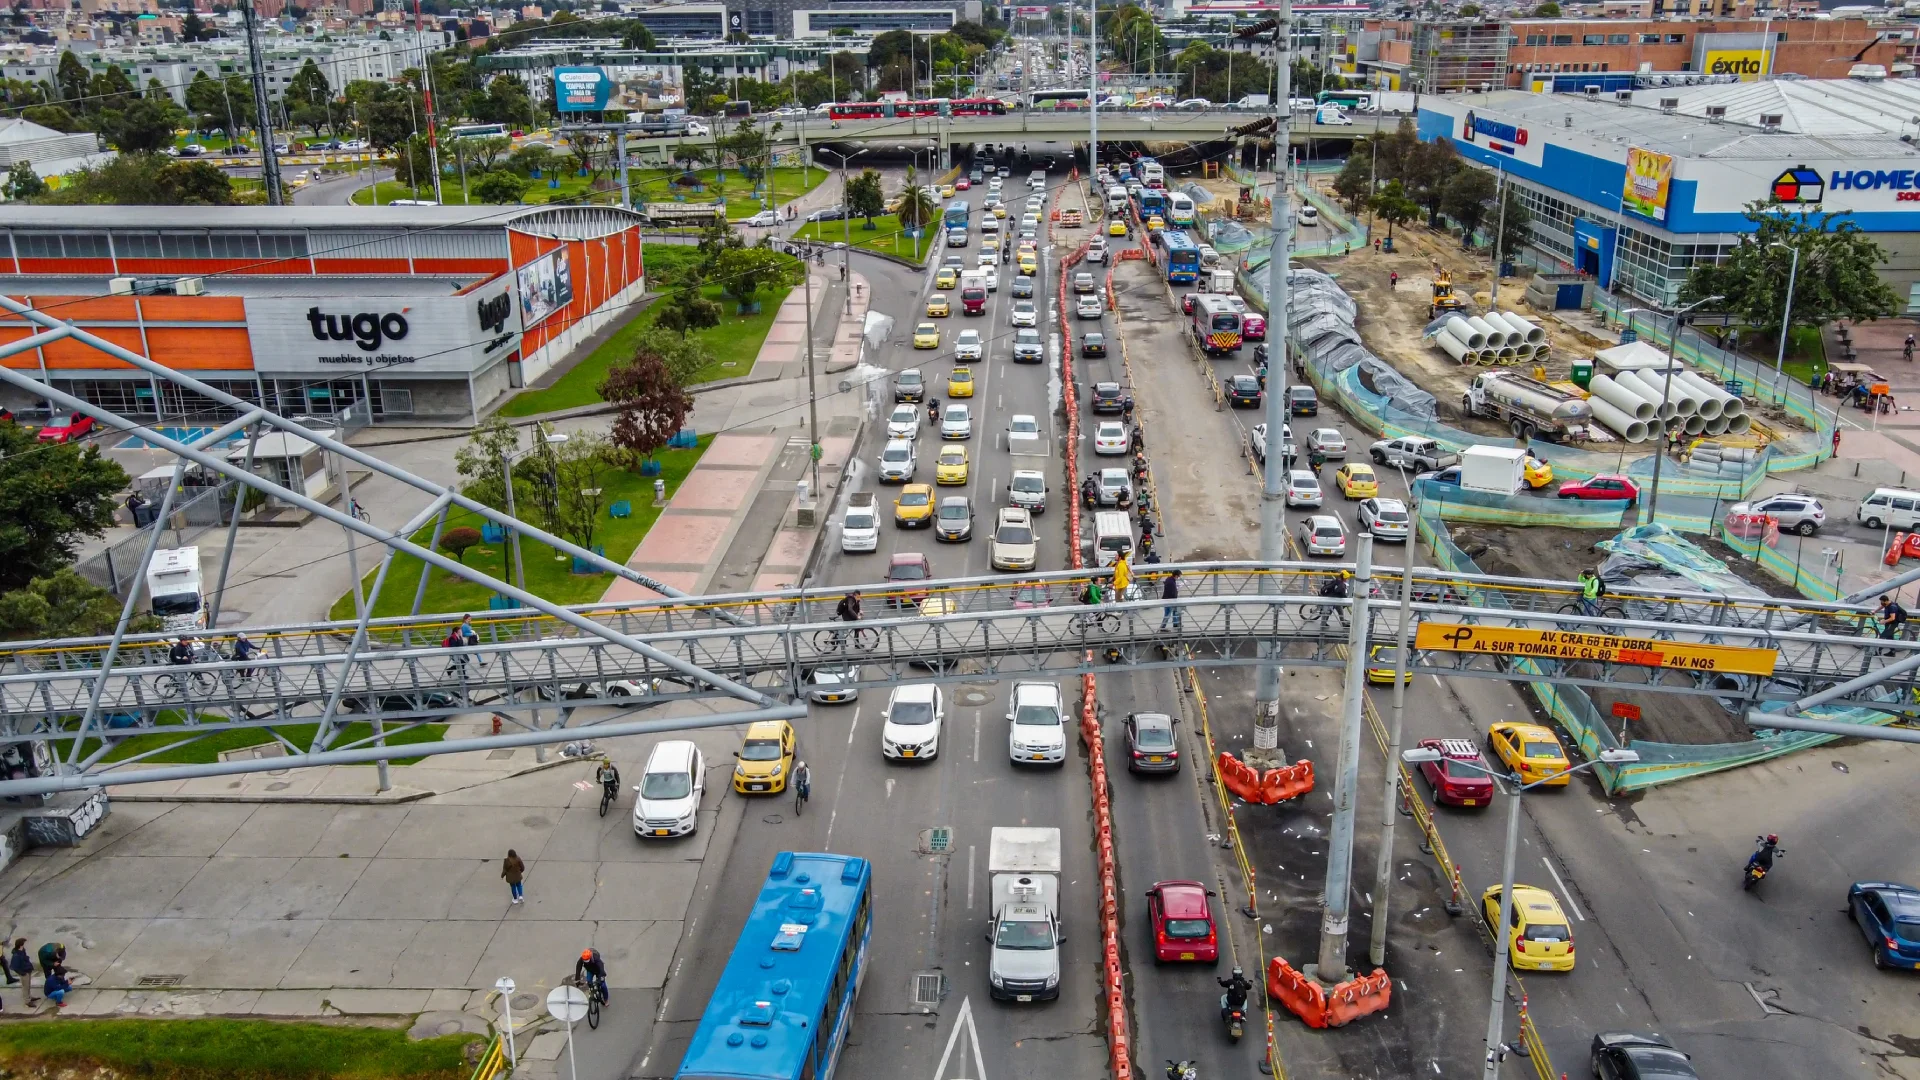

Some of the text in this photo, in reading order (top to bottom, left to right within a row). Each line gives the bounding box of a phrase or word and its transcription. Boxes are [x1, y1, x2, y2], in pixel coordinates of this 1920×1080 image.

[1711, 57, 1761, 74] éxito
[1830, 170, 1920, 190] HOME
[318, 354, 415, 366] muebles y objetos
[1473, 640, 1488, 650] AL
[1491, 641, 1515, 652] SUR
[1519, 642, 1556, 655] TOMAR
[1560, 646, 1577, 657] AV.
[1580, 648, 1594, 658] CL
[1598, 649, 1612, 660] 80
[1540, 632, 1653, 651] AV. CRA 68 EN OBRA
[1670, 656, 1687, 666] AV.
[1691, 657, 1715, 669] NQS
